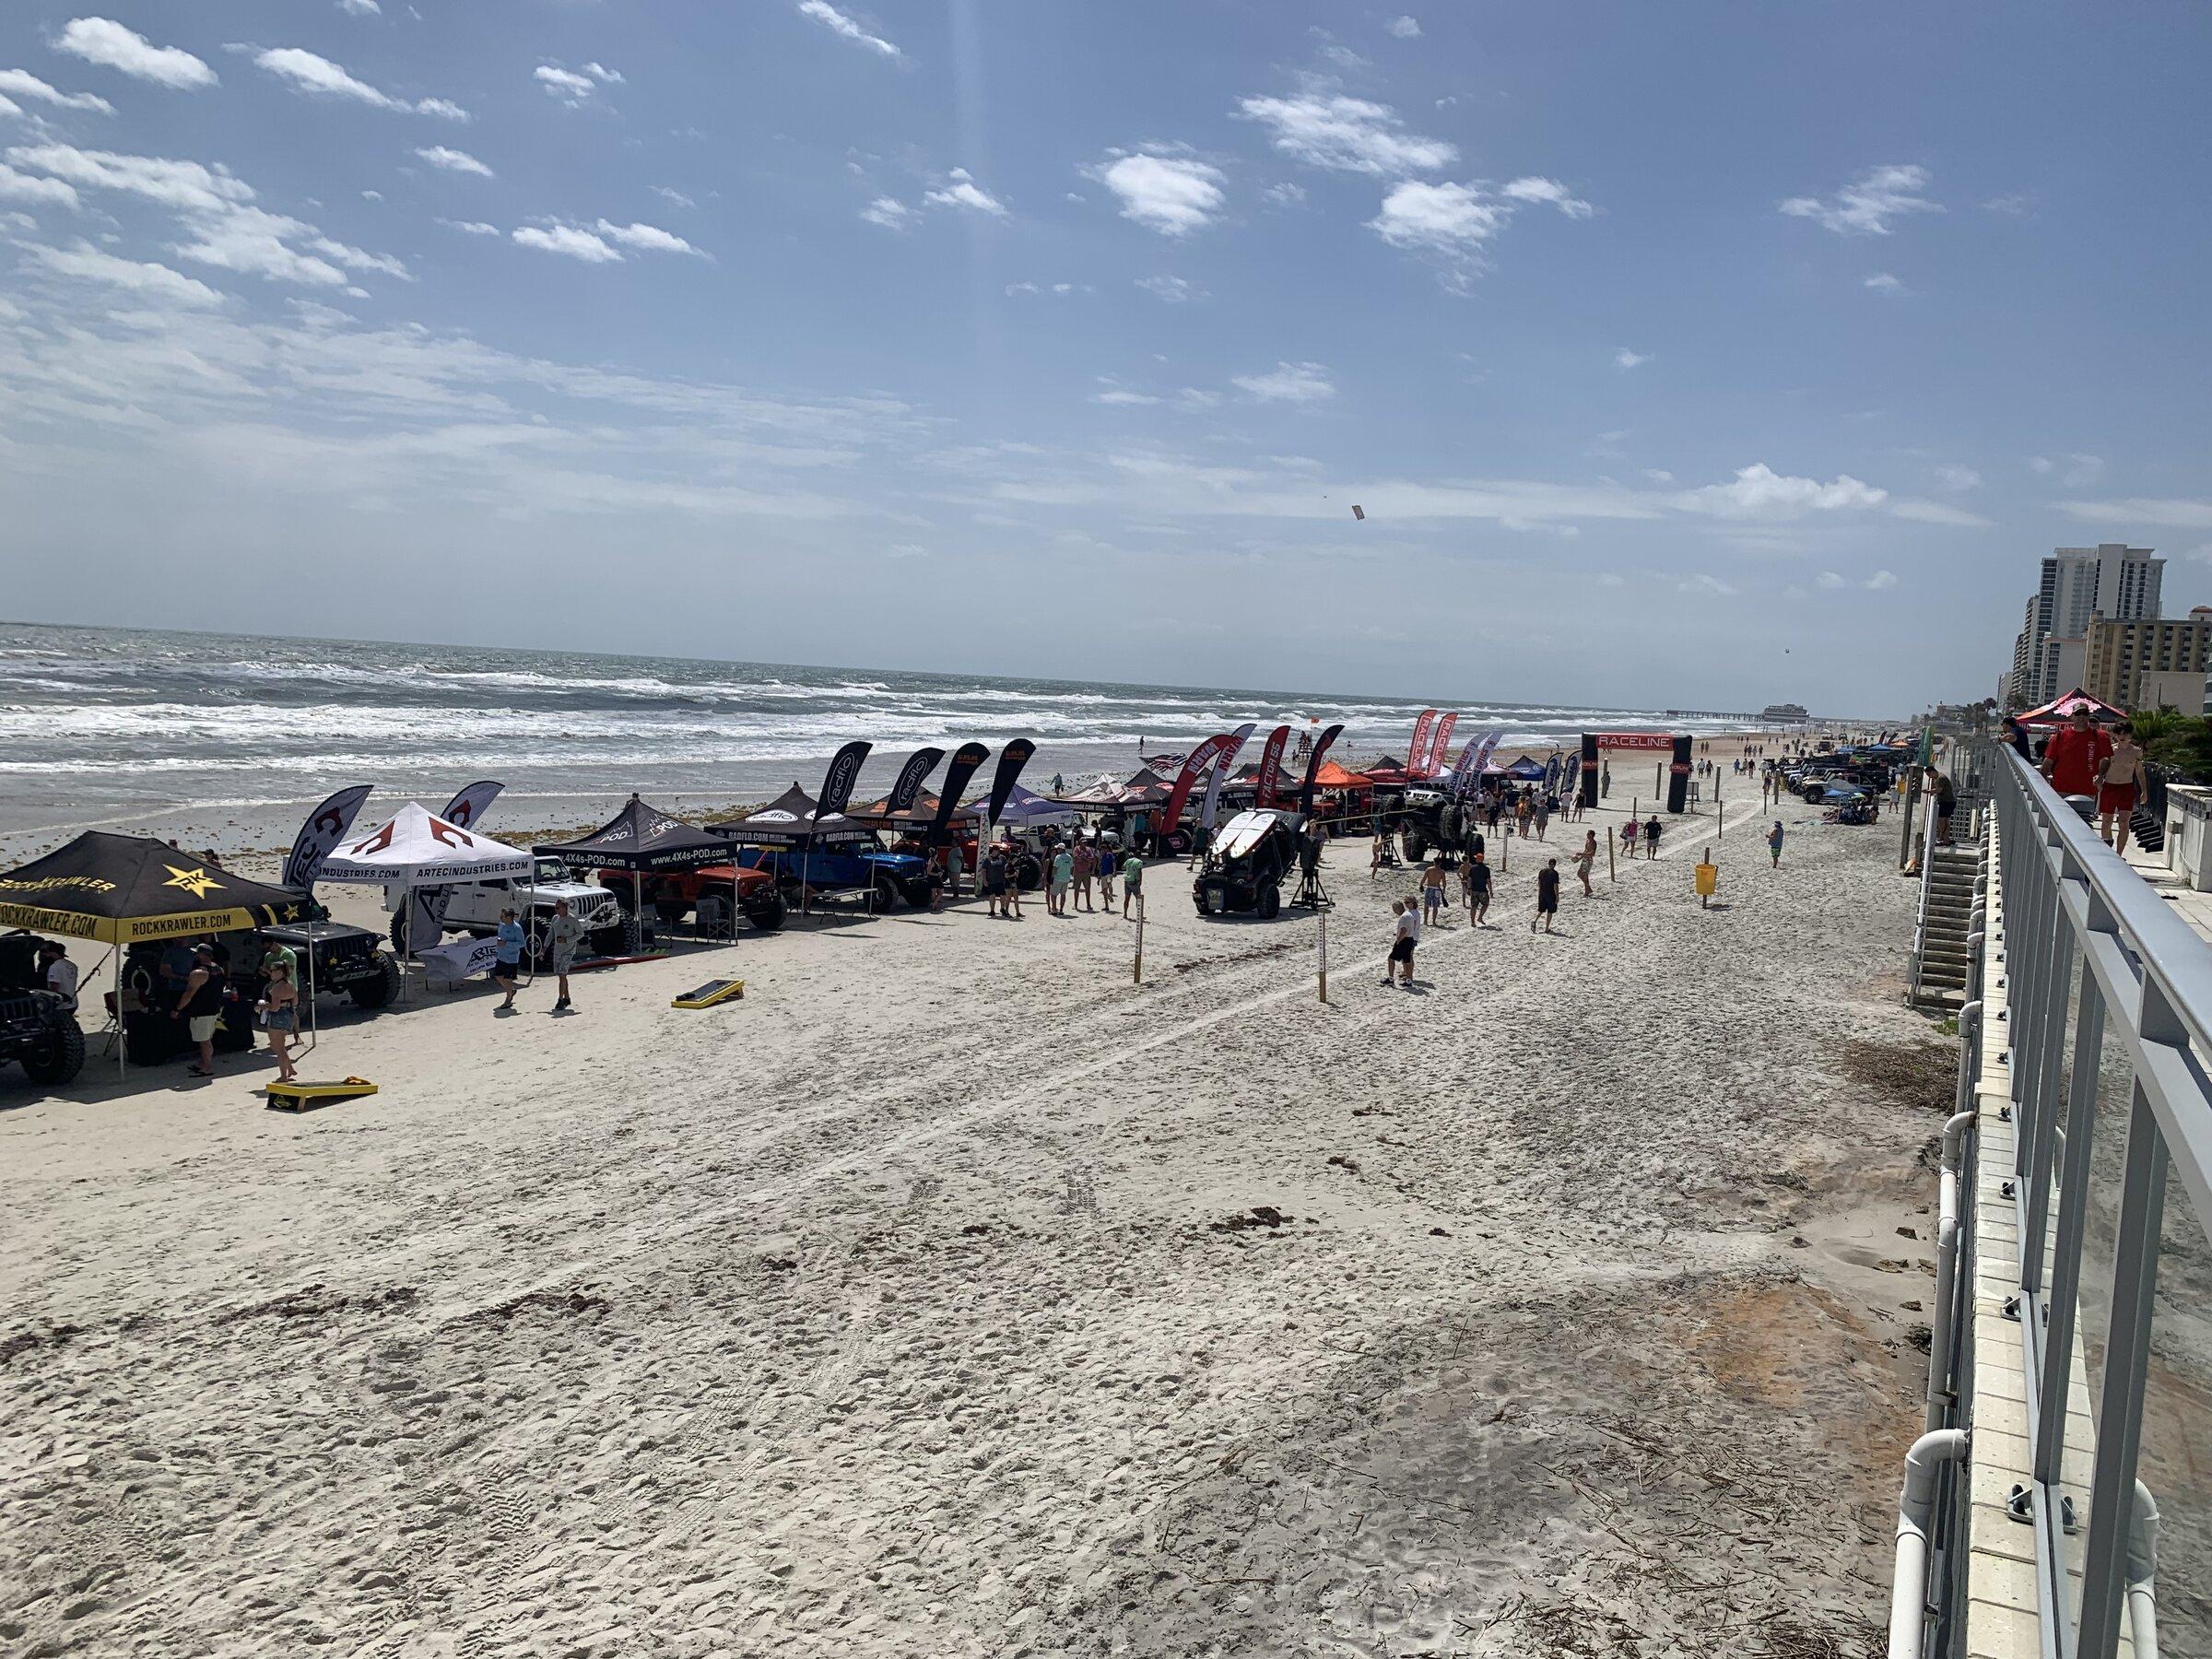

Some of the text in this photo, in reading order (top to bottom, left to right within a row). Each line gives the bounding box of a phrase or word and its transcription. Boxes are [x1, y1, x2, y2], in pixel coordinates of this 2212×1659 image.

[1218, 735, 1244, 772] WARN
[1413, 719, 1430, 771] RACELINE
[1431, 722, 1450, 772] RACELINE
[1598, 736, 1670, 747] RACELINE
[1187, 741, 1219, 774] WARN
[1456, 747, 1471, 771] OPTICS
[1476, 748, 1488, 770] OPTICS
[830, 756, 853, 803] radflo
[900, 759, 924, 800] radflo
[1263, 742, 1281, 799] FACTOR 55
[651, 848, 727, 865] www.4X4s-POD.com
[319, 867, 400, 879] INDUSTRIES.COM
[417, 861, 529, 878] ARTECINDUSTRIES.COM
[132, 914, 231, 936] ROCKKRAWLER.COM
[470, 945, 498, 963] ARTE
